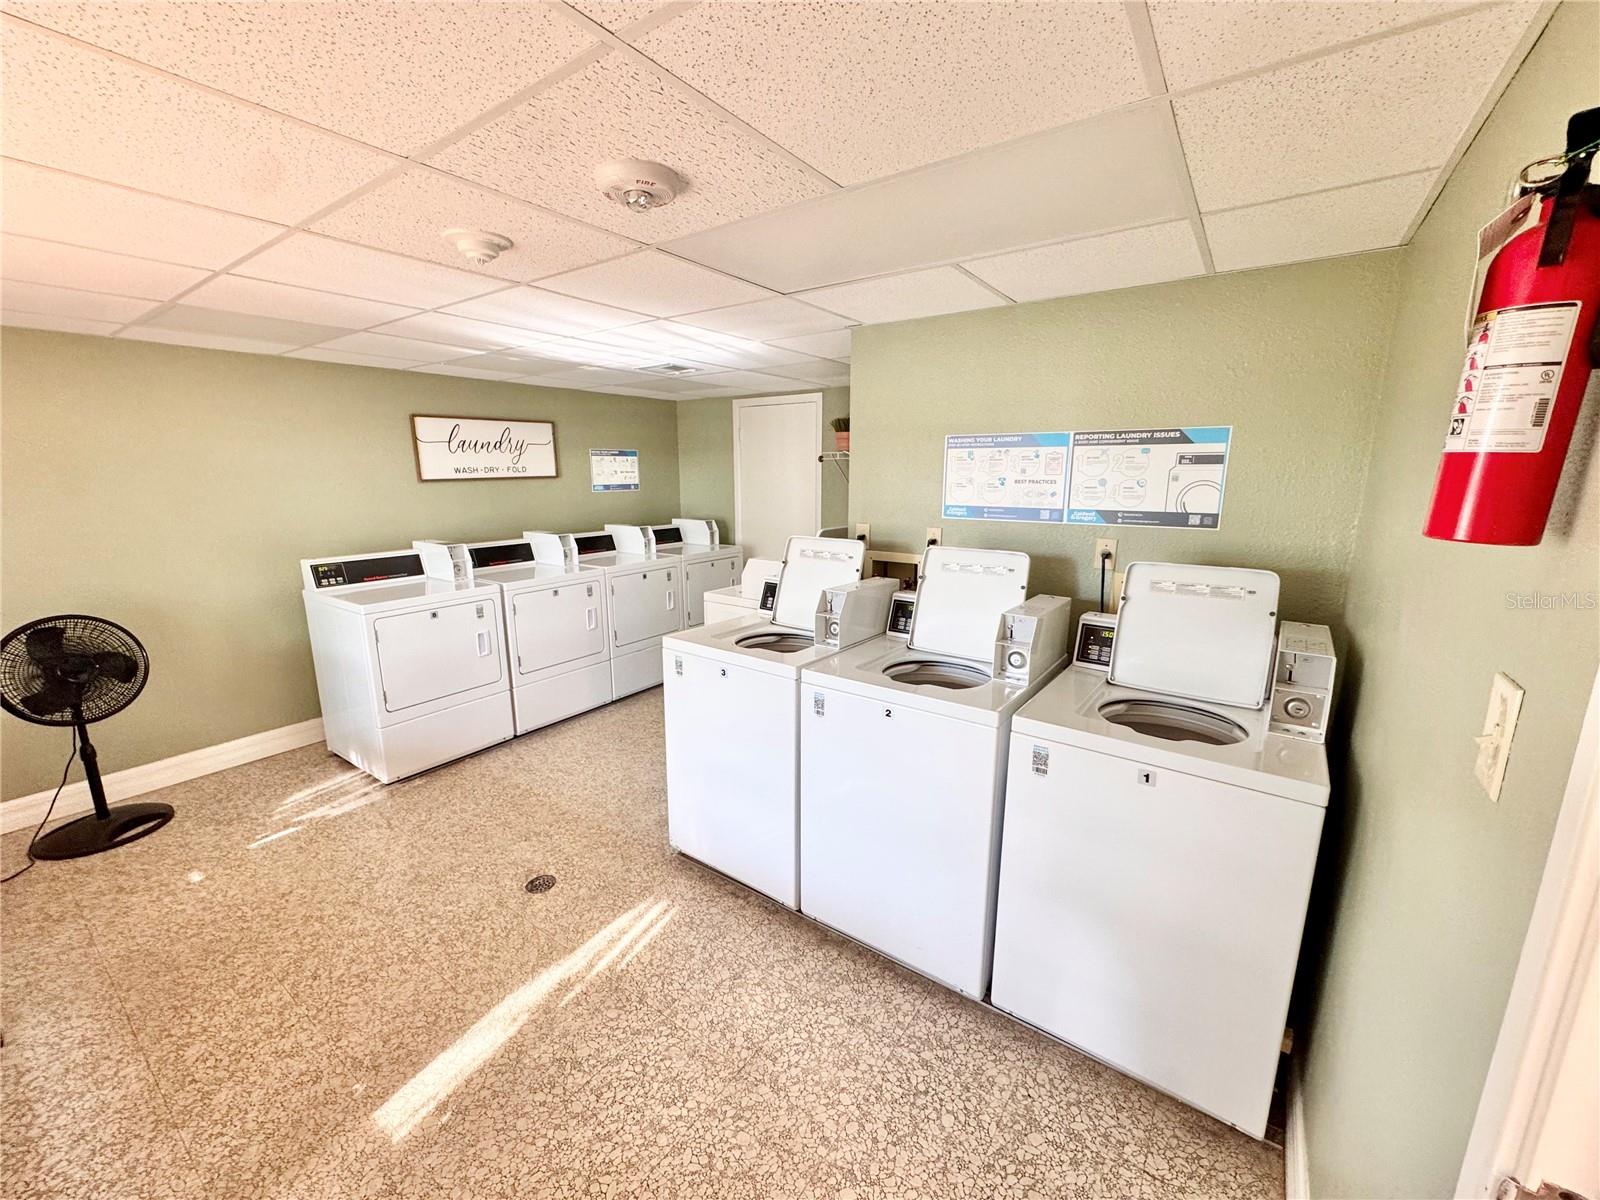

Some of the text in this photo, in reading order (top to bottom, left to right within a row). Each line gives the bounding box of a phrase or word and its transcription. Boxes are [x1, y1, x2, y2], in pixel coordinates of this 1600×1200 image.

[636, 179, 656, 187] FIRE
[447, 423, 530, 465] laundry
[720, 669, 726, 677] 3
[885, 709, 892, 717] 2
[1144, 774, 1150, 783] 1
